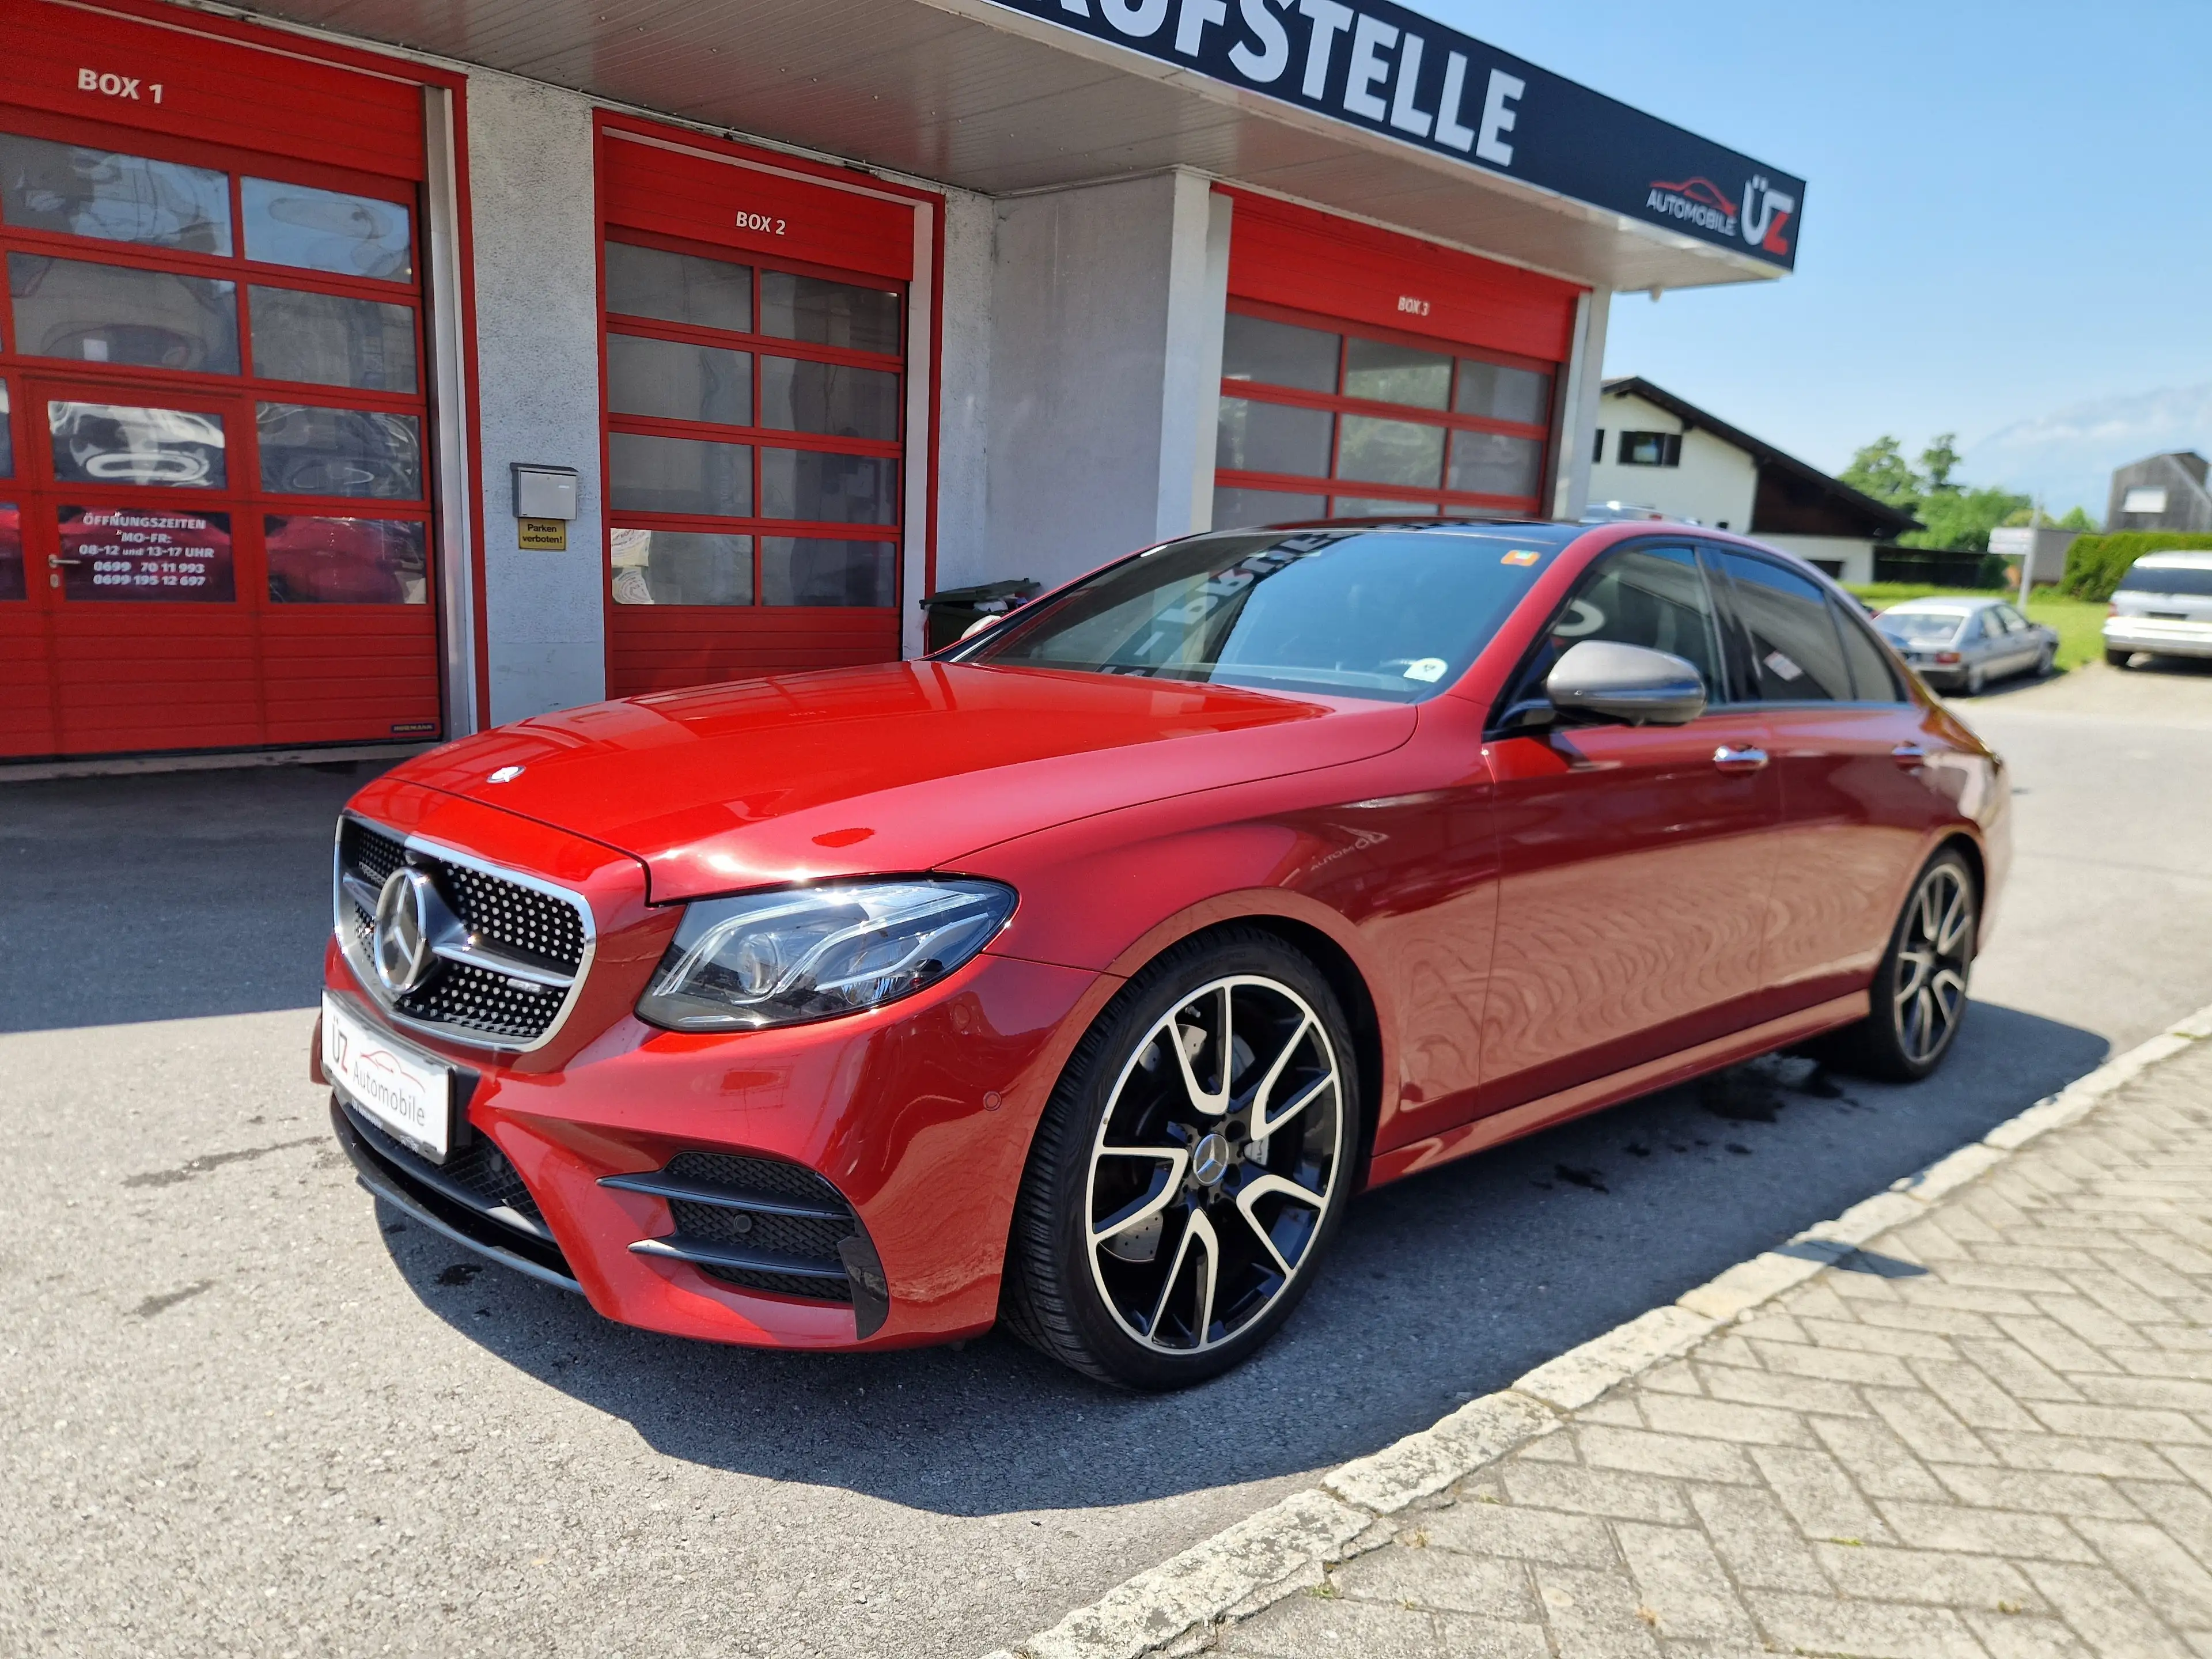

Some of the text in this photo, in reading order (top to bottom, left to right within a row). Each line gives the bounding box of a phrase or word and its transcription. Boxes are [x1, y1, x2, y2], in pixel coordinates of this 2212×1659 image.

[78, 67, 163, 104] BOX 1
[1646, 188, 1737, 237] AUTOMOBILE
[736, 211, 786, 235] BOX 2
[1397, 296, 1430, 316] BOX 3
[83, 512, 206, 529] ÖFFNUNGSZEITEN
[528, 524, 557, 533] Parken
[522, 535, 563, 544] verboten!
[79, 544, 215, 558] 08-12 und 13-17 UHR
[93, 560, 132, 573] 0699
[161, 575, 178, 586] 12
[353, 1061, 425, 1127] Automobile
